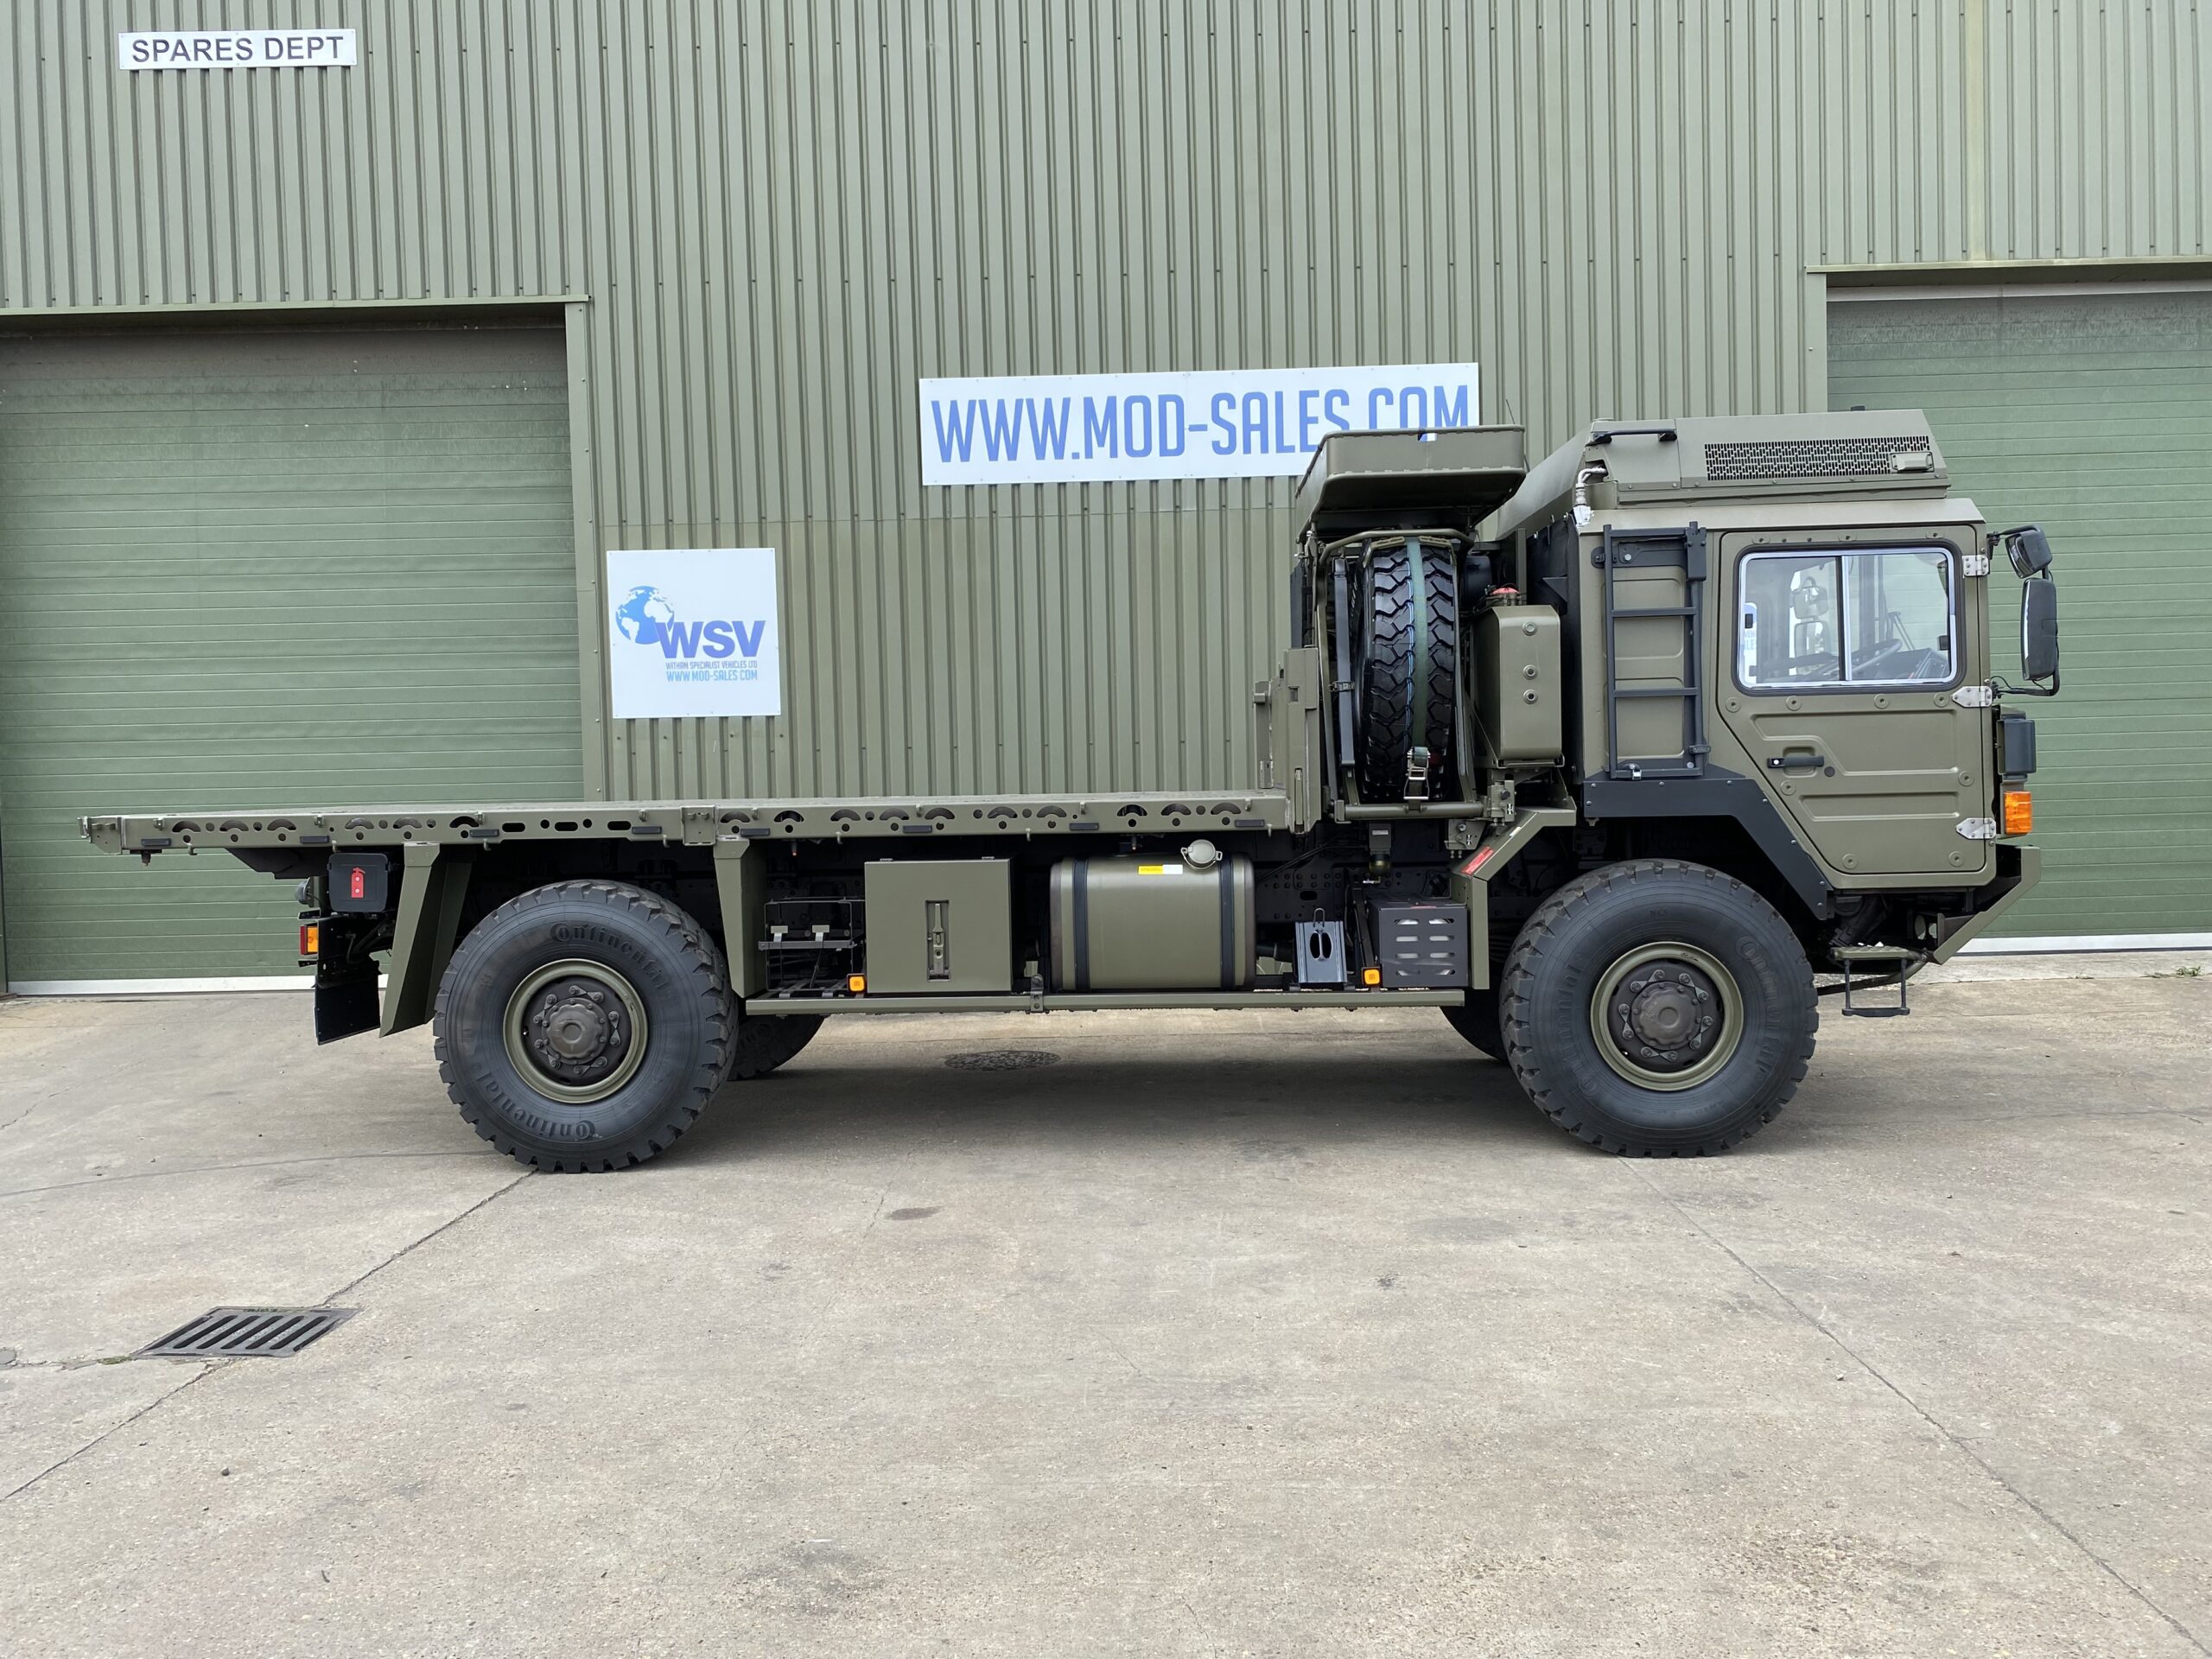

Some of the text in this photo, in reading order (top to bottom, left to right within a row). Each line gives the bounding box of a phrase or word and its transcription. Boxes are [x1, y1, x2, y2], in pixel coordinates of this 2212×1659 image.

[132, 36, 344, 63] SPARES DEPT
[931, 385, 1468, 462] WWW.MOD-SALESCOM
[655, 620, 766, 658] WSV
[664, 659, 758, 670] WITHAM SPECIALIST VEHICLES LTD
[666, 670, 758, 682] WWWMOD-SALESCOM
[549, 922, 671, 989] Continental
[475, 1071, 596, 1141] Continental
